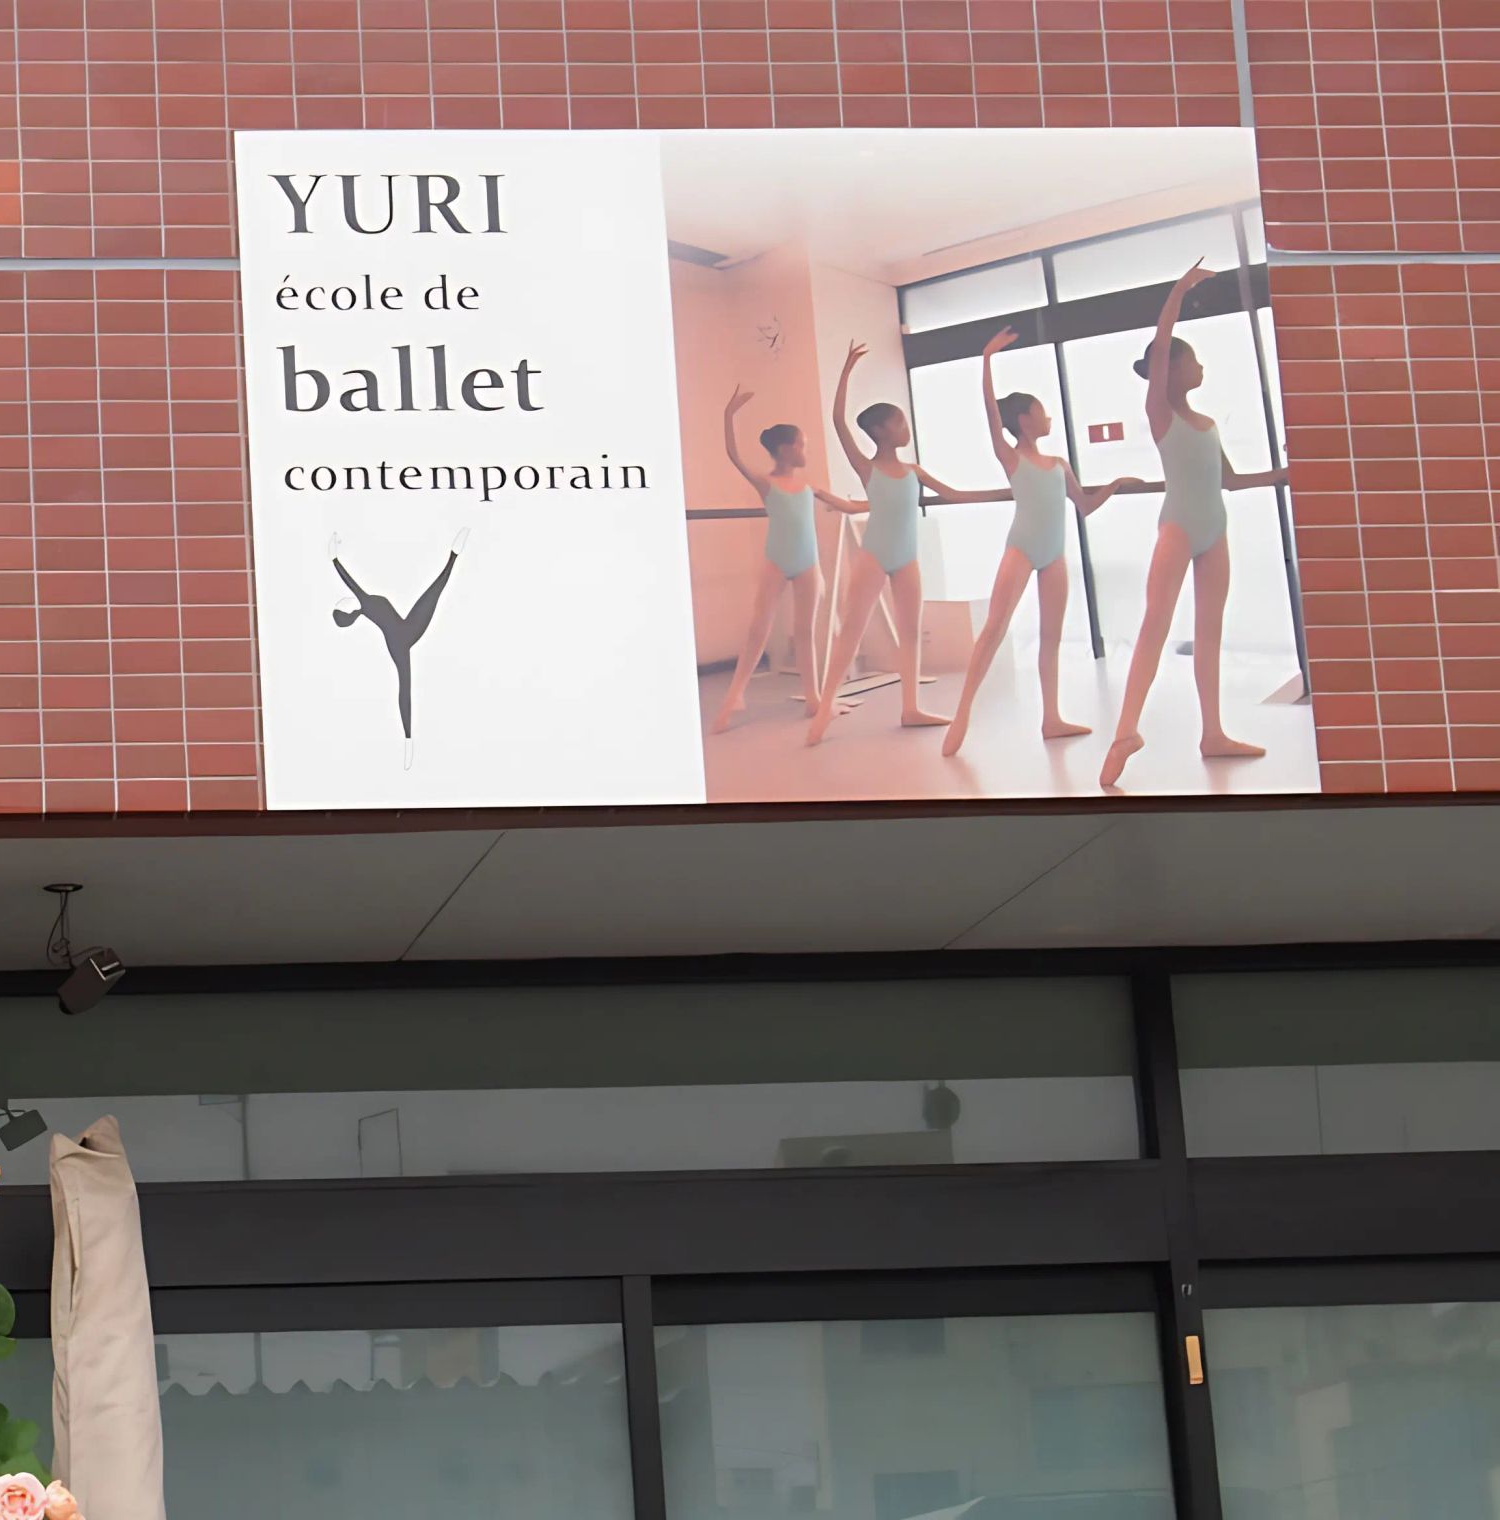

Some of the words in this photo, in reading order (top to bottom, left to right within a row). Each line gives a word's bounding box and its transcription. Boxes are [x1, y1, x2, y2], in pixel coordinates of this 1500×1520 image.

[267, 173, 509, 235] YURI
[275, 274, 404, 311] école
[424, 273, 481, 311] de
[276, 344, 545, 413] ballet
[283, 453, 651, 502] contemporain
